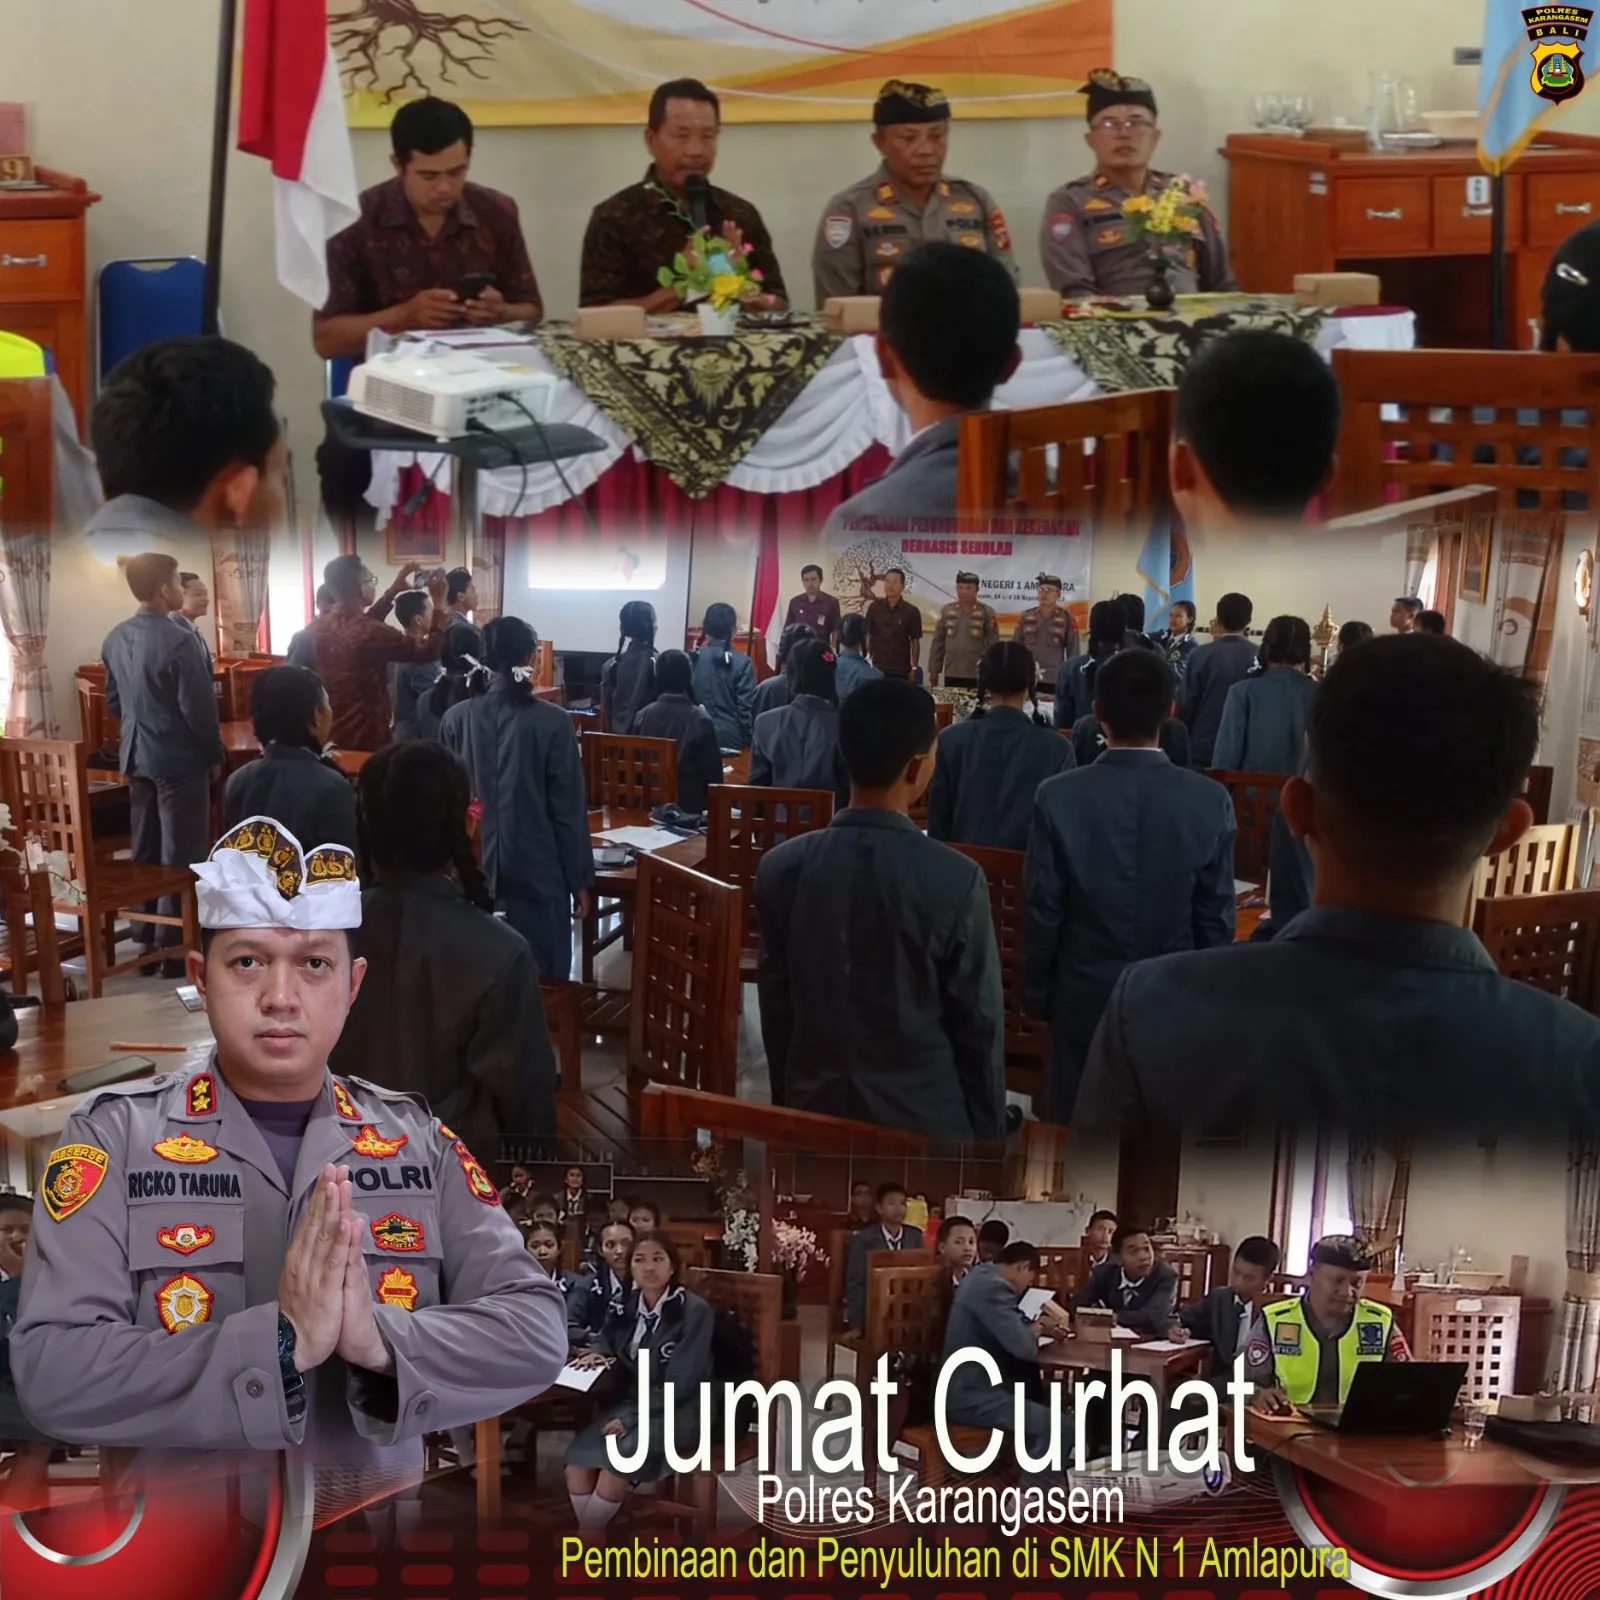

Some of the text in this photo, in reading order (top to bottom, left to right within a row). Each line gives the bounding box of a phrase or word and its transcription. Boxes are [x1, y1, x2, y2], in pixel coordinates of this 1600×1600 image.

[981, 580, 1014, 589] NEGERI
[128, 1170, 242, 1198] RICKO TARUNA
[348, 1165, 432, 1191] OLRI
